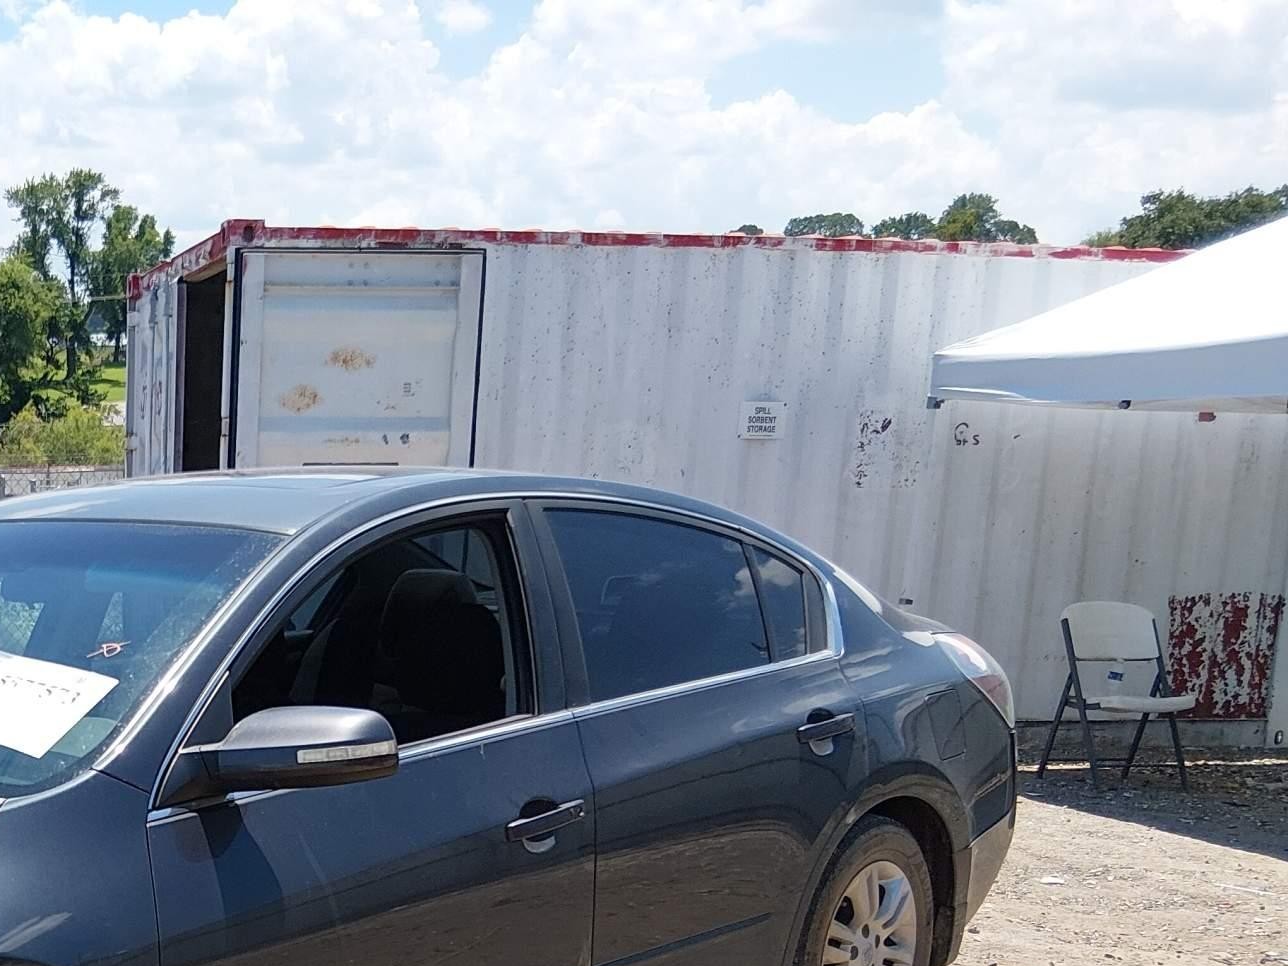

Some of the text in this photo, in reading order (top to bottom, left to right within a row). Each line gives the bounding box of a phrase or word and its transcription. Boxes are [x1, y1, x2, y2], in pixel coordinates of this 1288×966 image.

[754, 406, 772, 415] SPILL
[747, 416, 777, 424] SORBENT
[746, 425, 776, 433] STORAGE
